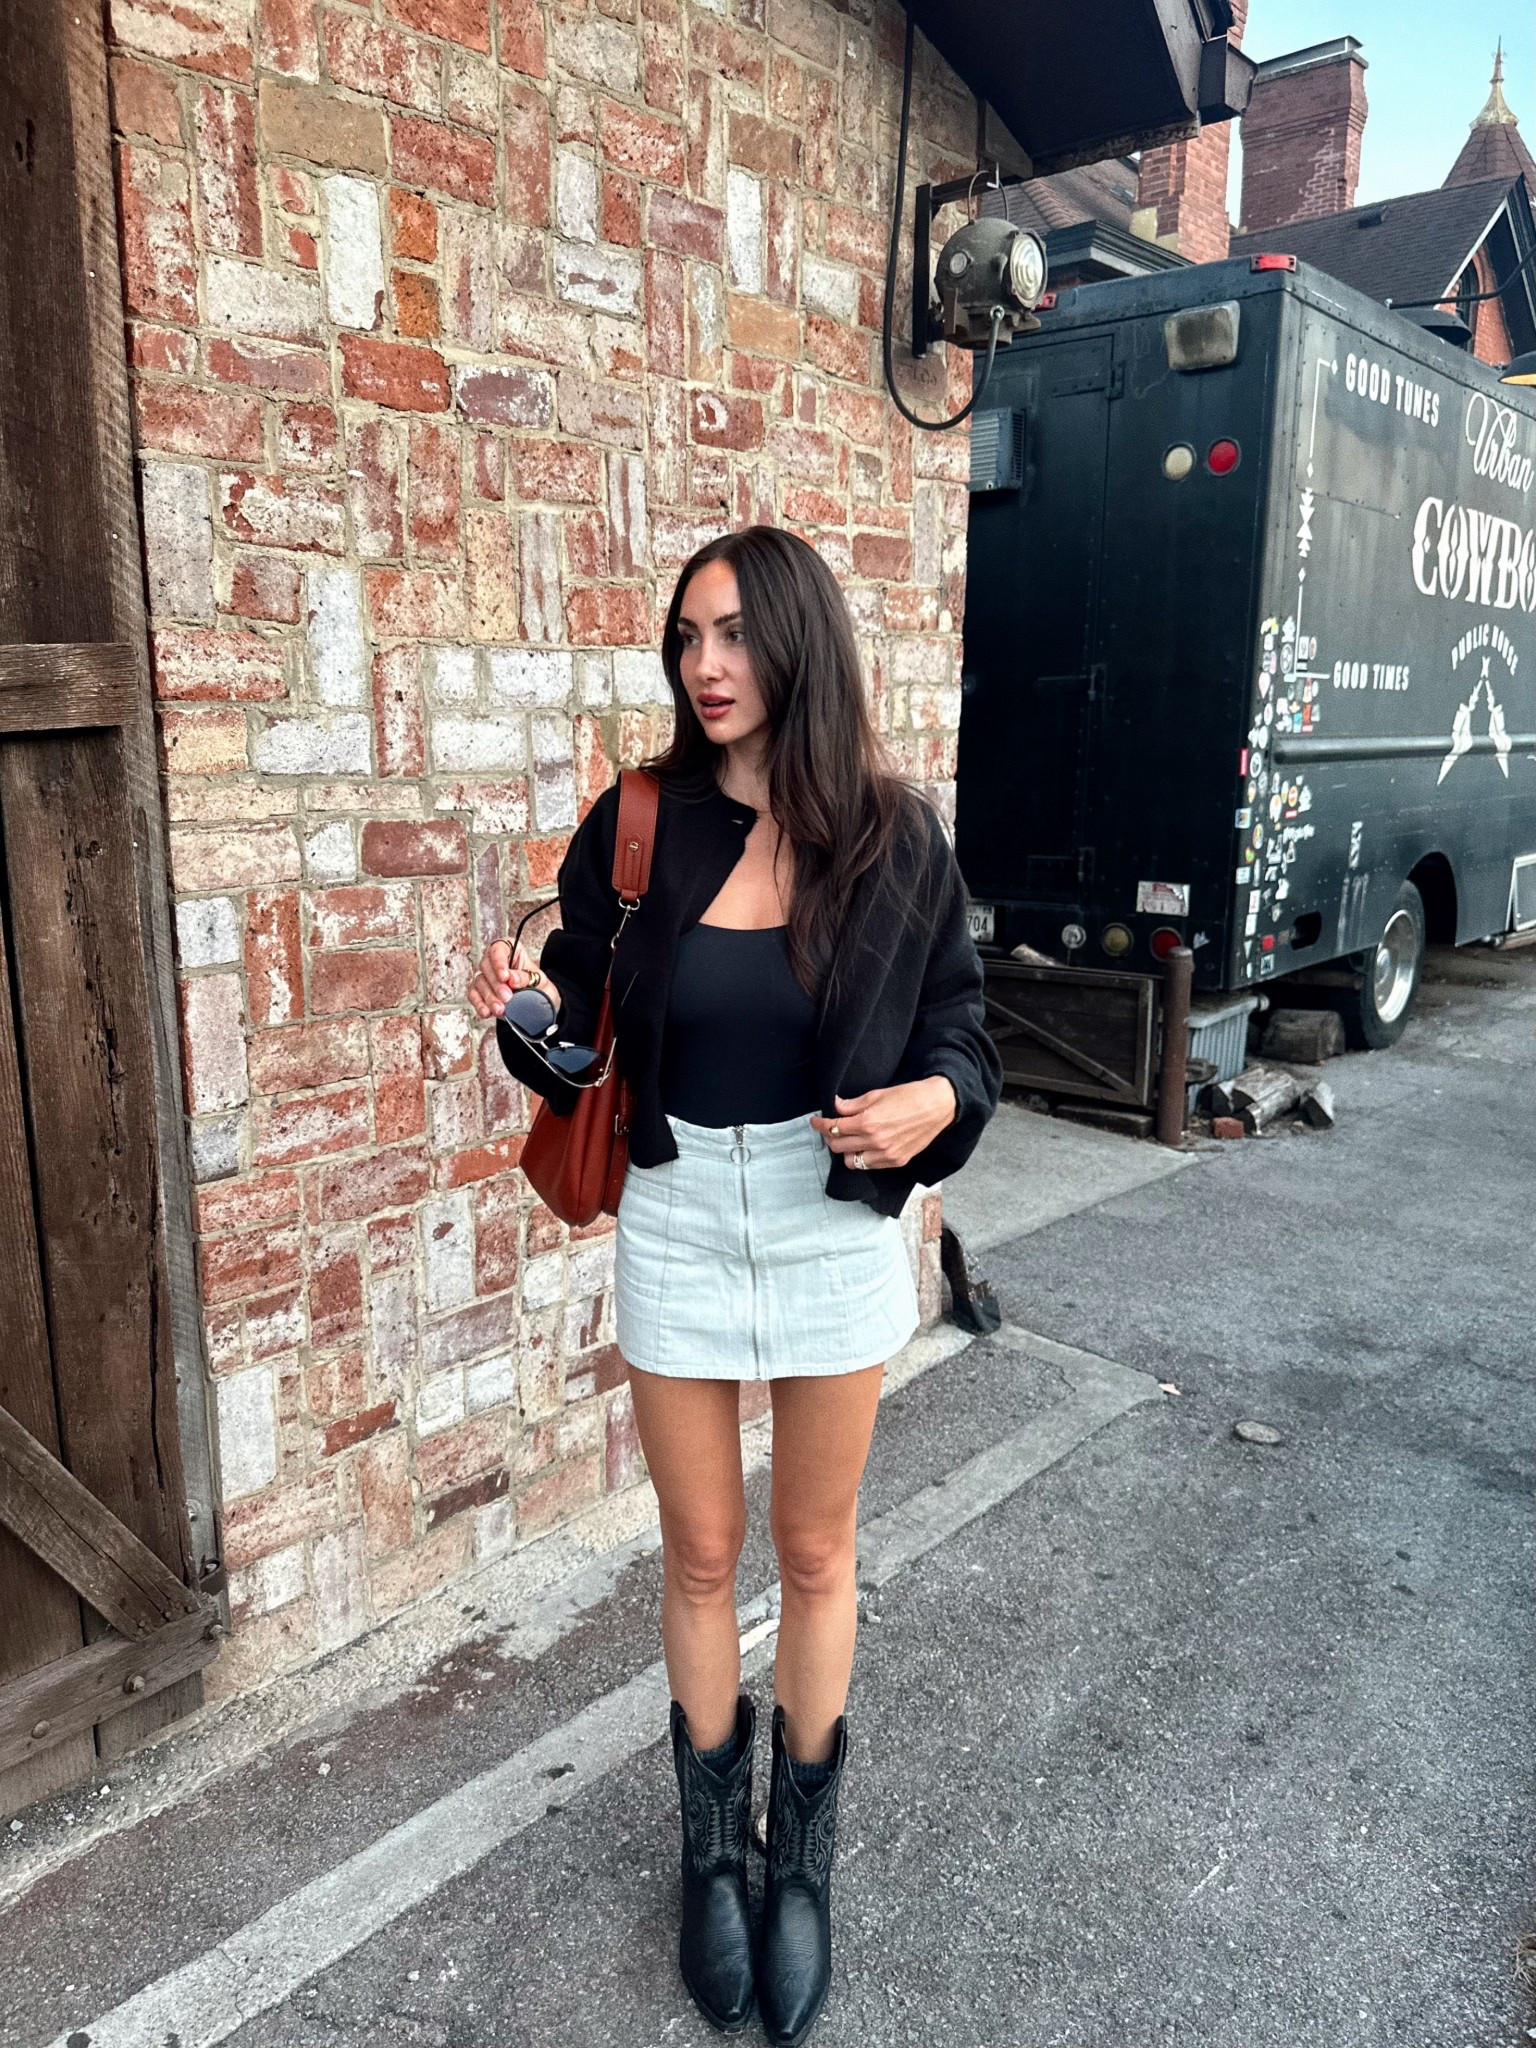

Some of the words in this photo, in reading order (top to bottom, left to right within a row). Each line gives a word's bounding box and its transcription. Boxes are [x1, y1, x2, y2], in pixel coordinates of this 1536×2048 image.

[1345, 353, 1391, 405] GOOD
[1396, 375, 1440, 427] TUNES
[1465, 392, 1535, 493] Urban
[1333, 660, 1369, 690] GOOD
[1372, 663, 1410, 691] TIMES
[1451, 623, 1489, 671] PUBLIC
[1491, 625, 1519, 676] HOUSE
